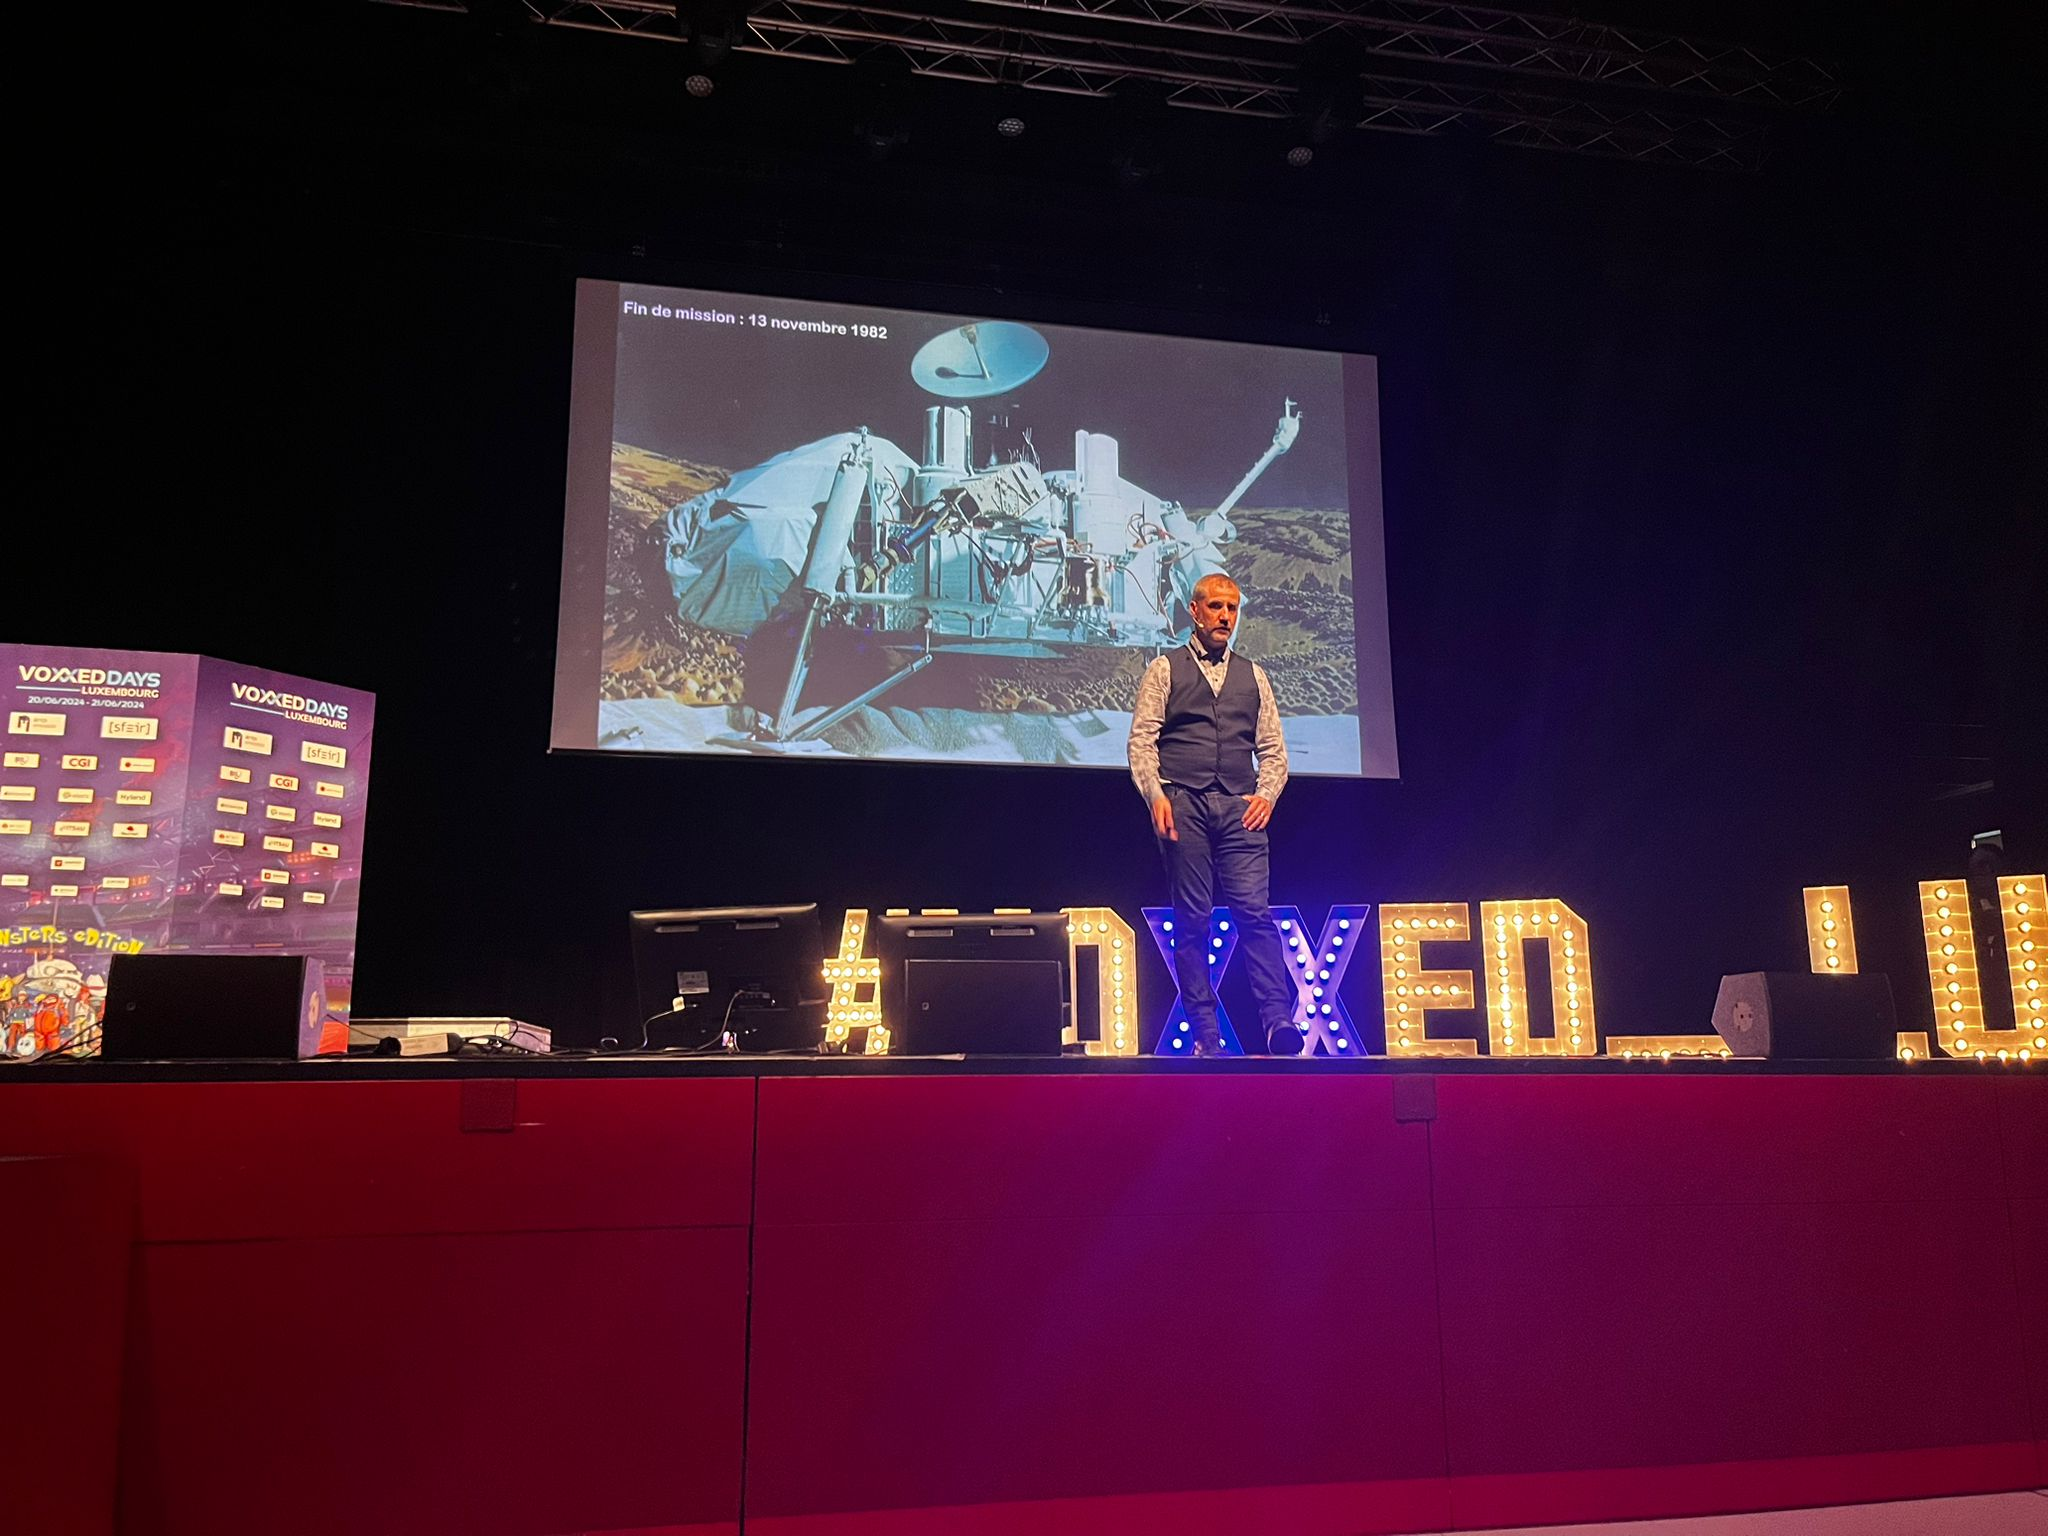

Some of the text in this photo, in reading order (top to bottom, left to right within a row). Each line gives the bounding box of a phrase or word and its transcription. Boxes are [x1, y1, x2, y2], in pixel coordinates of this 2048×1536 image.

[623, 301, 648, 315] Fin
[652, 304, 672, 318] de
[675, 307, 736, 325] mission
[748, 314, 767, 327] 13
[771, 318, 847, 335] novembre
[850, 324, 888, 339] 1982
[81, 686, 160, 699] LUXEMBOURG
[28, 696, 85, 706] 20/06/2024
[91, 698, 145, 709] 21/06/2024
[284, 710, 347, 730] LUXEMBOURG
[69, 758, 91, 767] CGI
[275, 777, 294, 788] CGI
